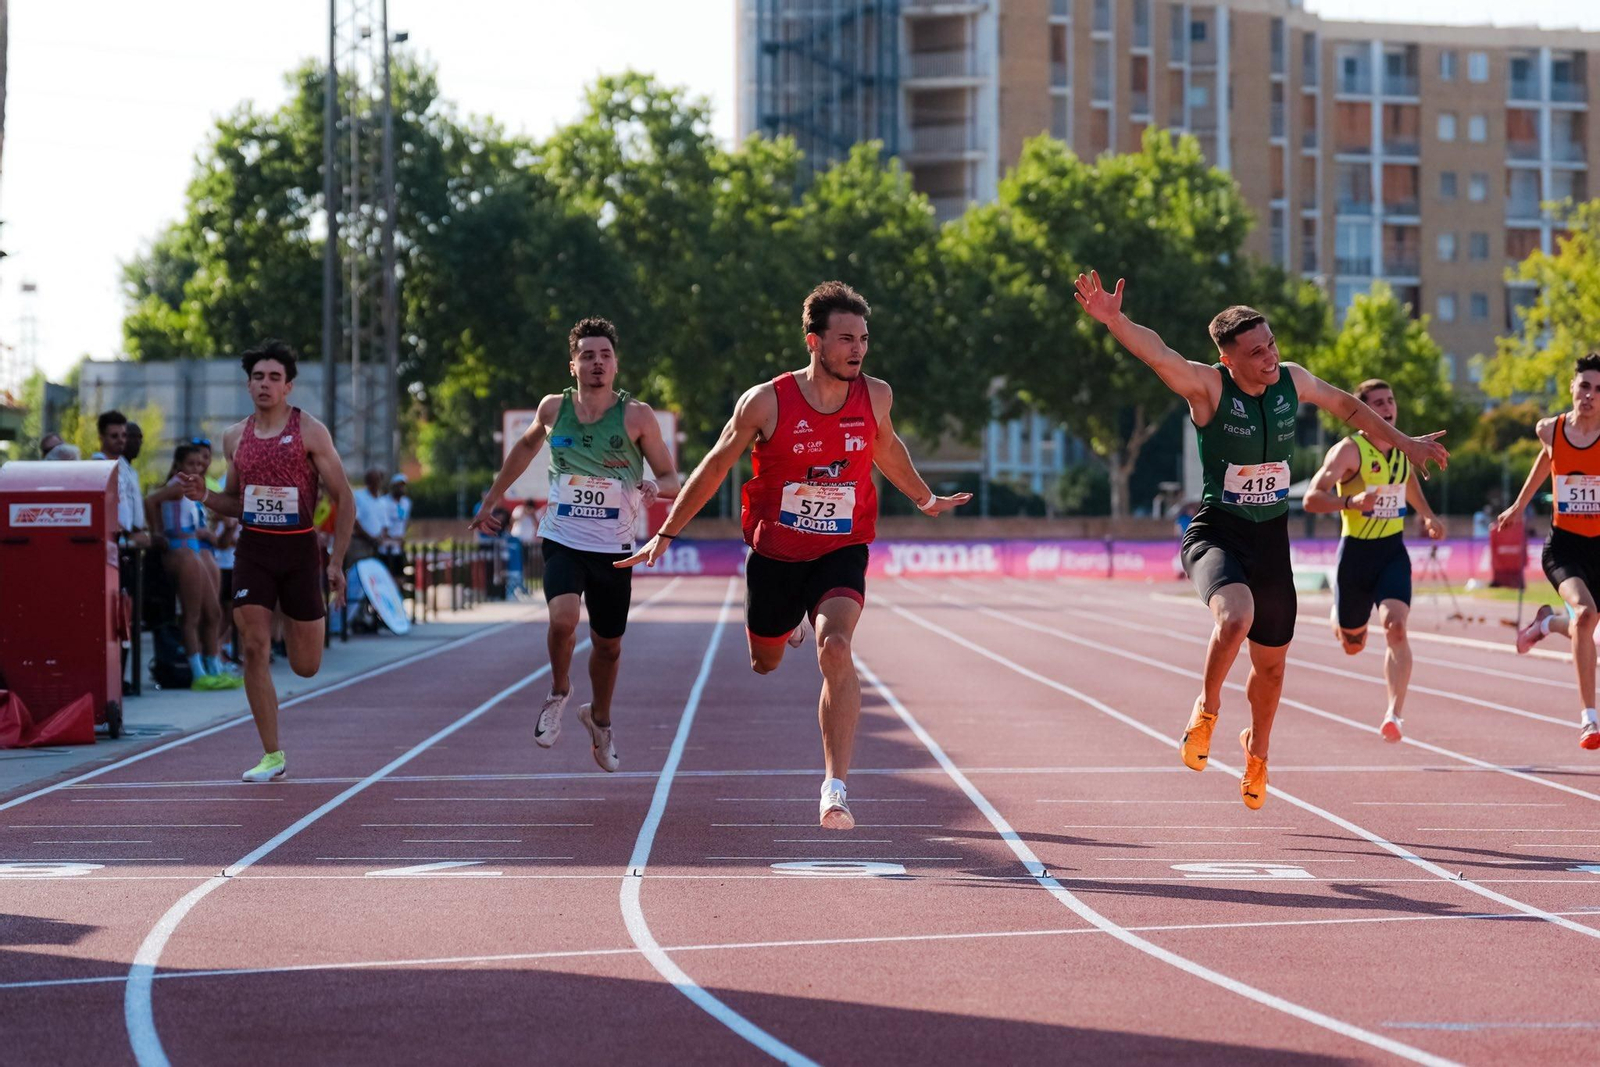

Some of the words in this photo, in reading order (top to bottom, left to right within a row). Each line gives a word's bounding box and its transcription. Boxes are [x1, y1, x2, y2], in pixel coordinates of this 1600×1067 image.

[1242, 476, 1276, 492] 418
[573, 489, 605, 506] 390
[1375, 495, 1398, 508] 473
[1570, 488, 1595, 501] 511
[257, 499, 283, 512] 554
[800, 500, 836, 518] 573
